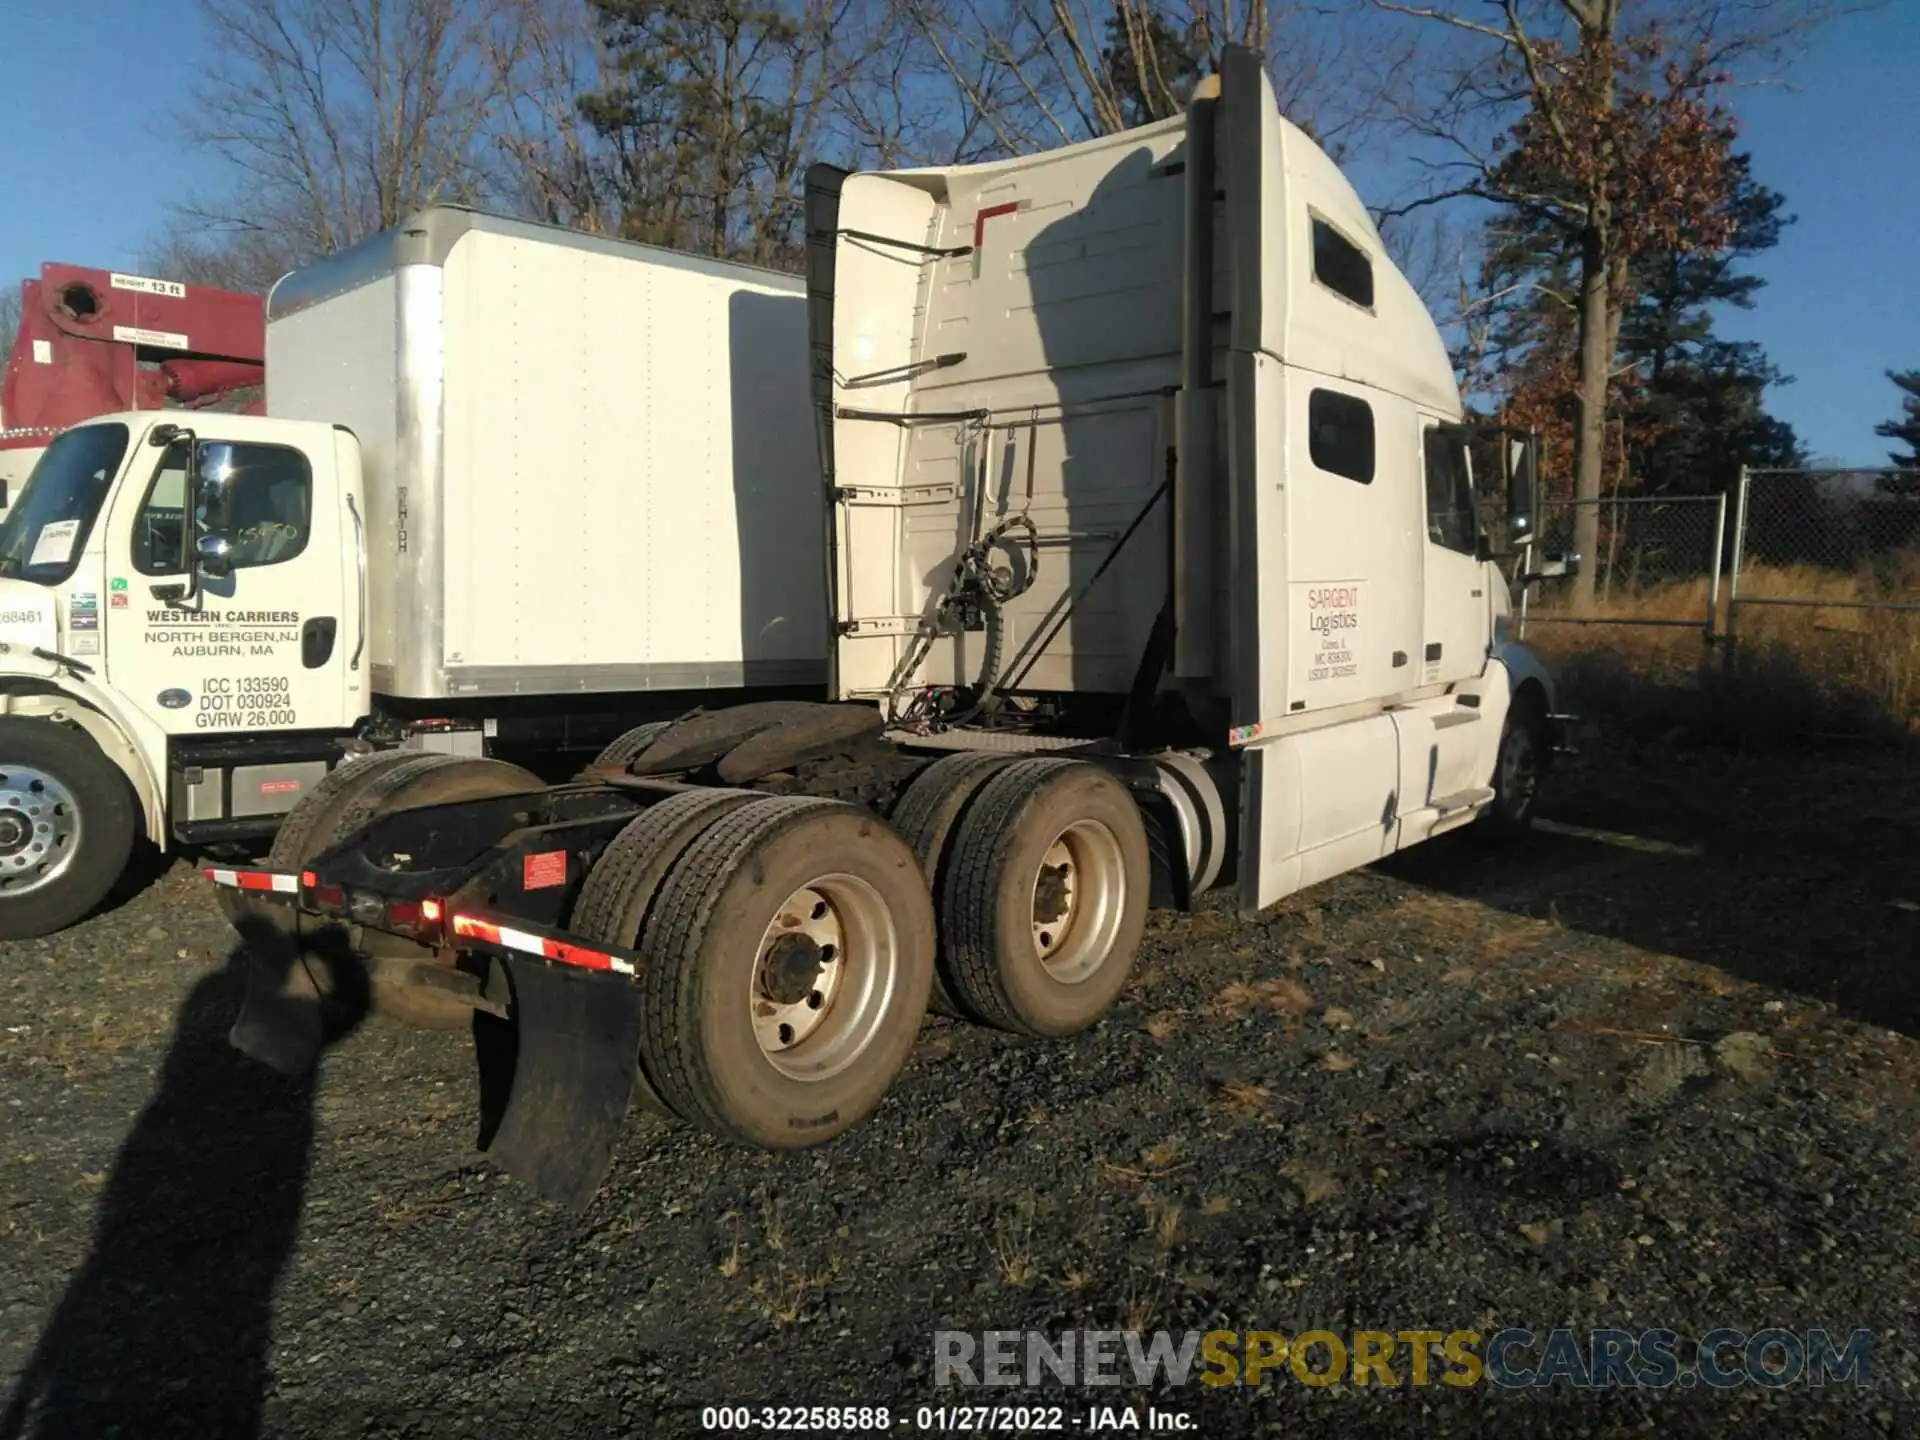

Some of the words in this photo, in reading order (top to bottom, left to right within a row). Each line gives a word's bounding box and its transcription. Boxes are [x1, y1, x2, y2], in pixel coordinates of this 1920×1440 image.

[152, 281, 166, 293] 13
[170, 284, 181, 295] ft
[1308, 587, 1358, 609] SARGENT
[147, 610, 220, 622] WESTERN
[226, 611, 300, 622] CARRIERS
[1309, 611, 1358, 636] Logistics
[145, 632, 203, 643] NORTH
[172, 646, 246, 657] AUBURN,
[250, 646, 274, 655] MA
[203, 678, 230, 693] ICC
[236, 677, 289, 692] 133590
[200, 695, 233, 710] DOT
[237, 693, 291, 709] 030924
[195, 713, 243, 728] GVRW
[247, 710, 296, 727] 26,000
